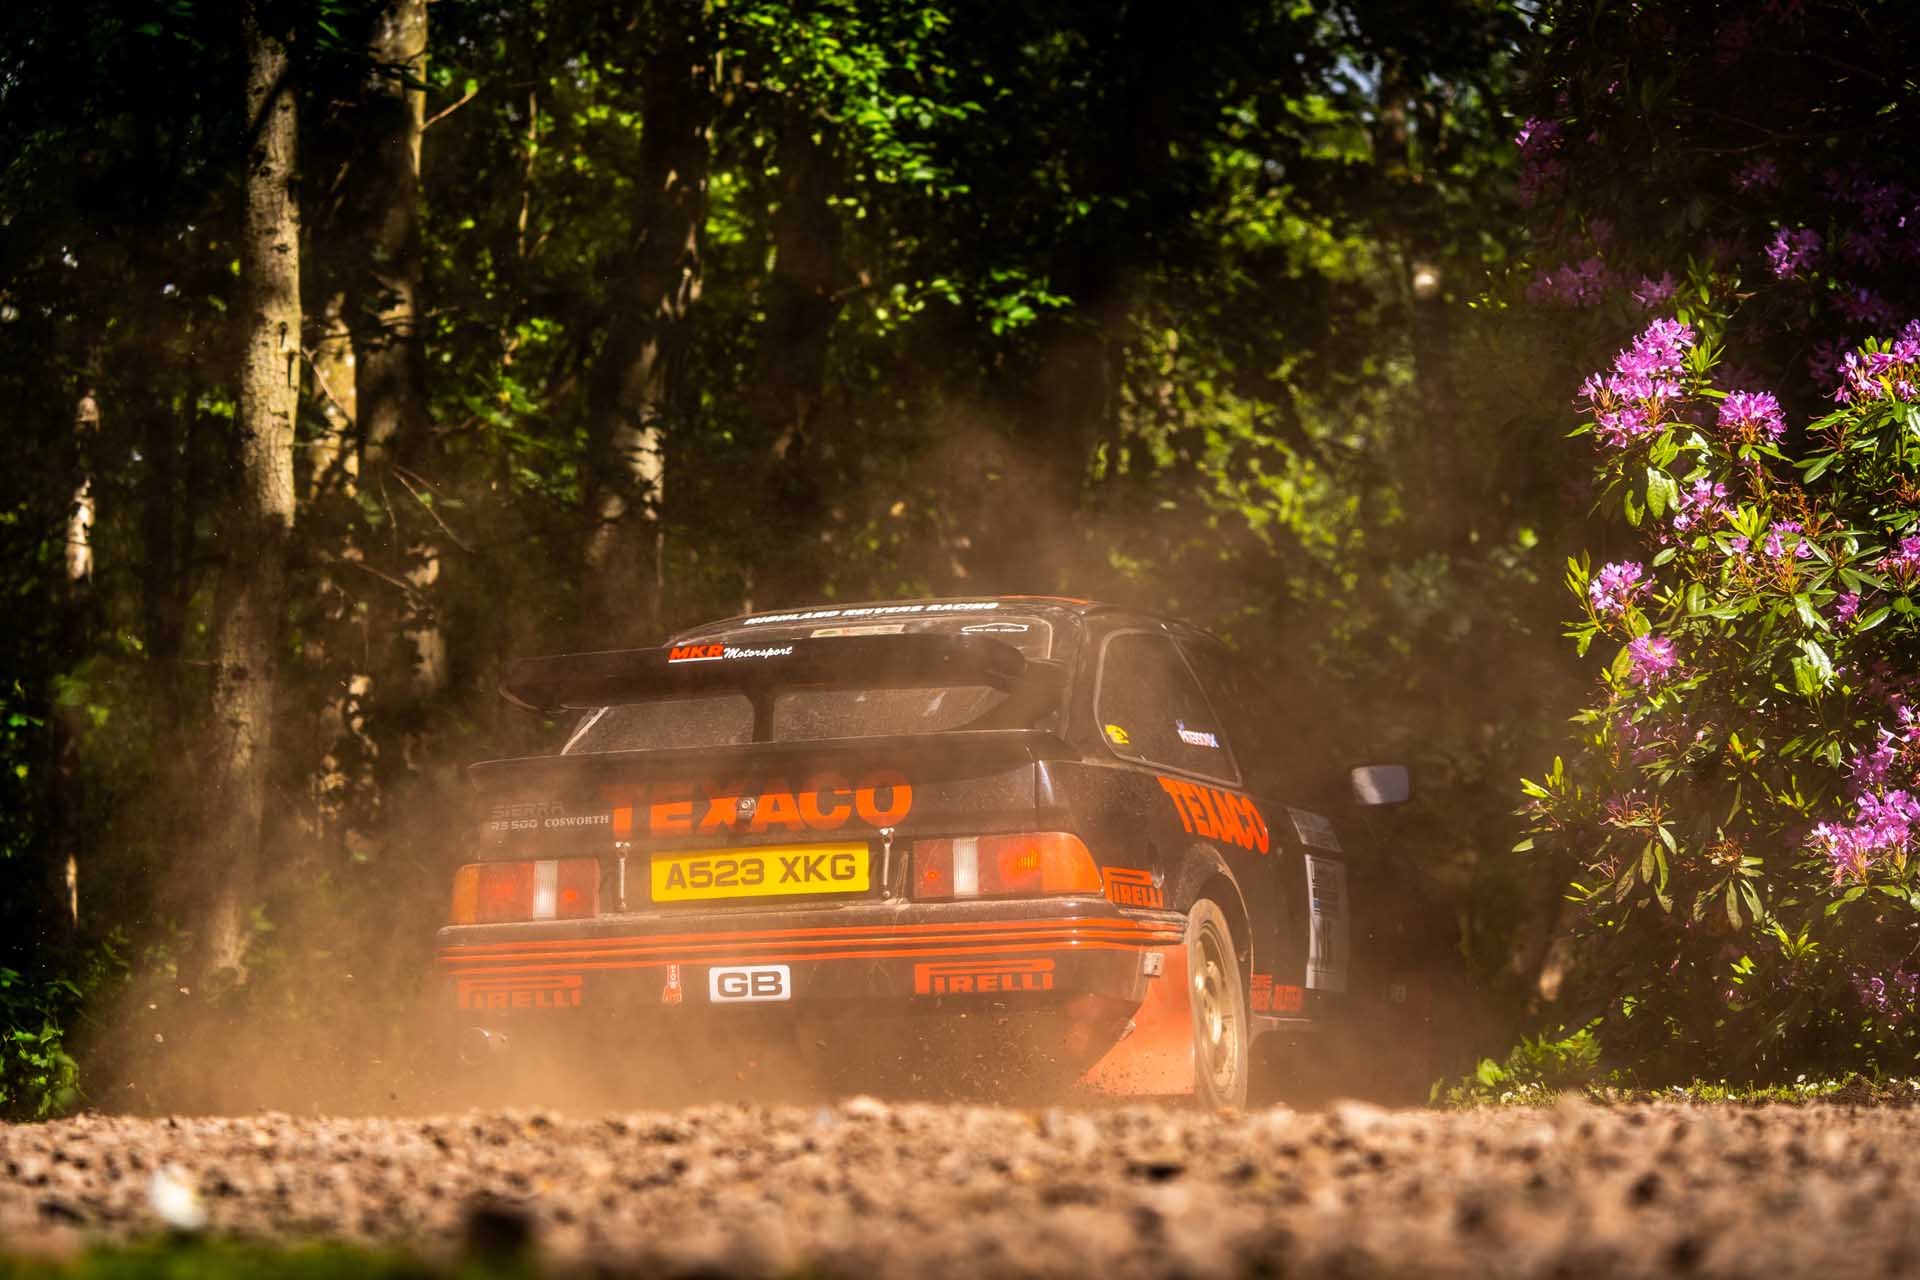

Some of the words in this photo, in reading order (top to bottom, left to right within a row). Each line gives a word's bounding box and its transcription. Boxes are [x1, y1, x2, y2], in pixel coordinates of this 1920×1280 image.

[926, 602, 1000, 612] RACING
[669, 644, 724, 660] MKR
[723, 645, 793, 660] Motorsport
[491, 800, 567, 819] SIERRA
[544, 815, 609, 828] COSWORTH
[602, 772, 913, 839] TEXACO
[1156, 775, 1269, 855] TEXACO
[665, 857, 765, 890] A523
[779, 854, 856, 884] XKG
[1102, 866, 1164, 909] PIRELLI
[457, 974, 584, 1009] PIRELLI
[717, 971, 783, 998] GB
[914, 958, 1056, 994] PIRELLI
